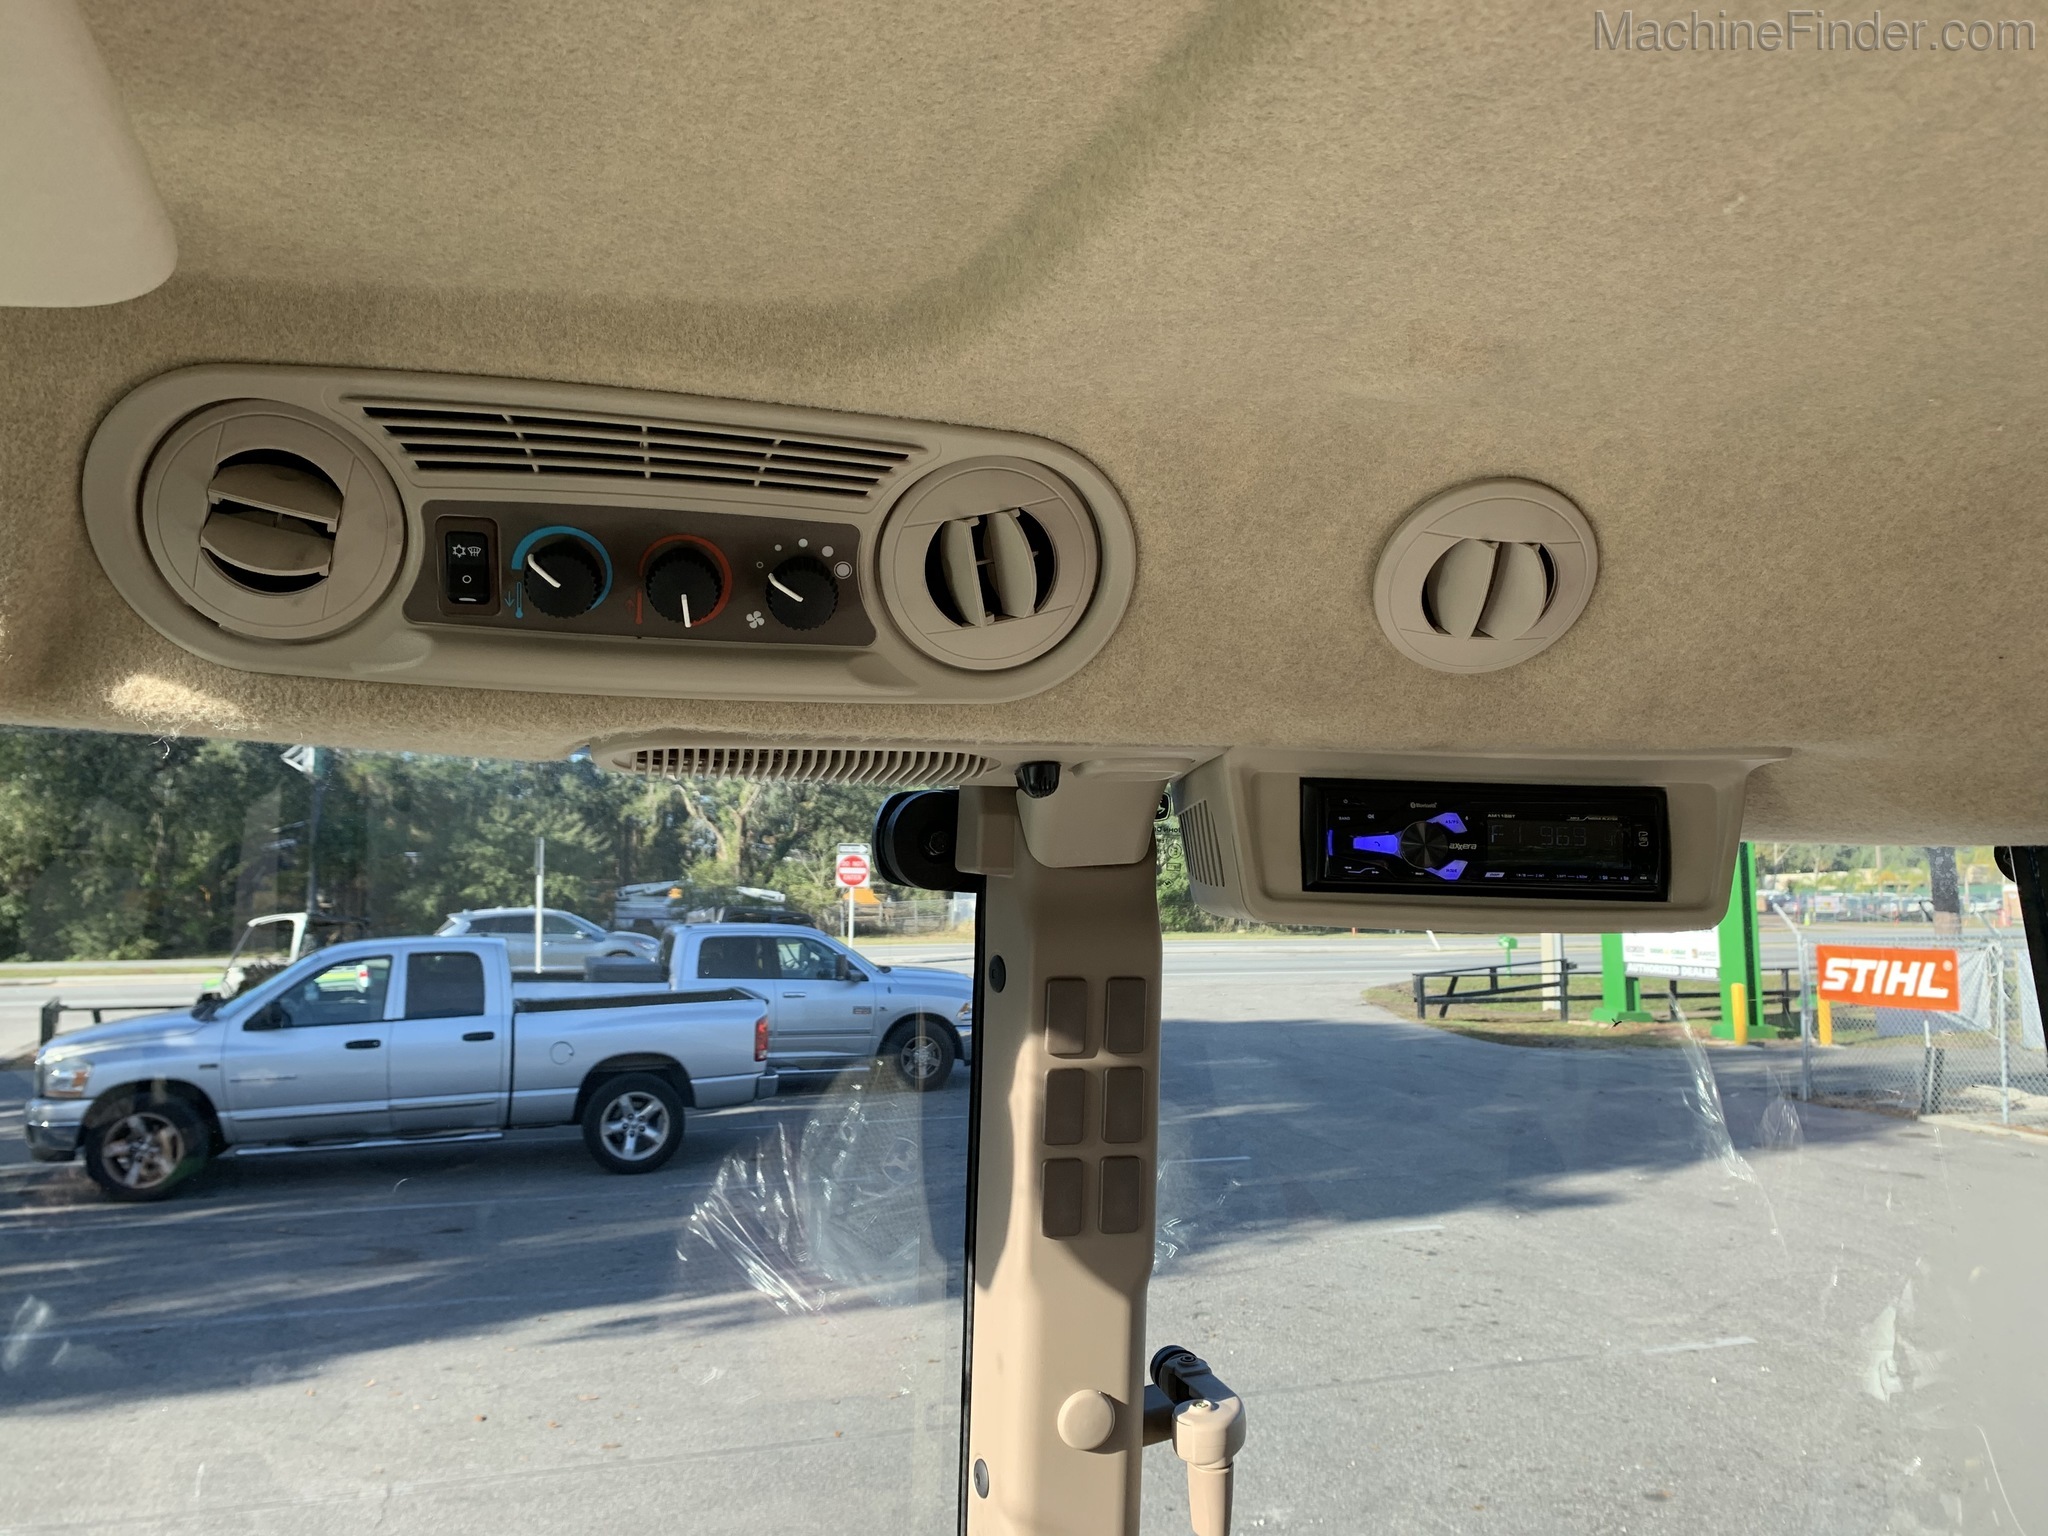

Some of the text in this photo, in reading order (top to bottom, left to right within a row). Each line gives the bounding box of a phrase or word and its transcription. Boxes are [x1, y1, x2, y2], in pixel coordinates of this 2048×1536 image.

[1626, 962, 1718, 979] AUTHORIZED DEALER
[1821, 957, 1949, 999] STIHL
